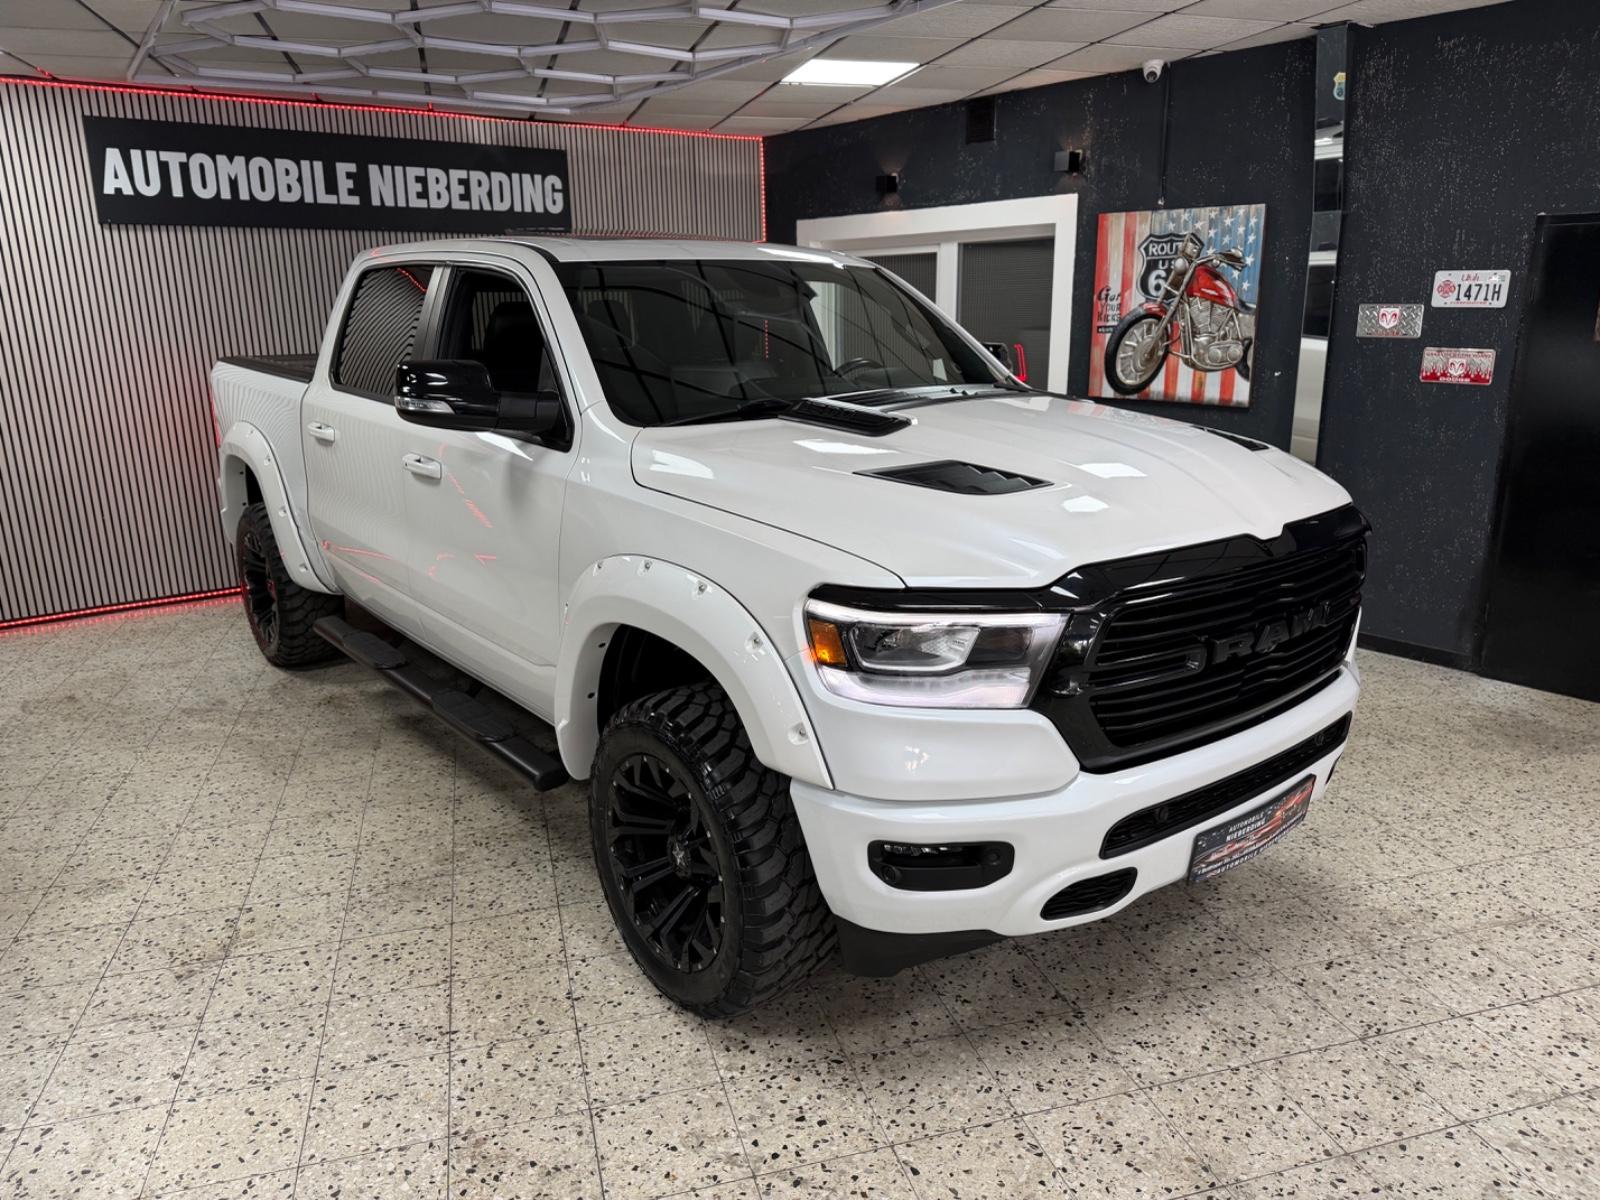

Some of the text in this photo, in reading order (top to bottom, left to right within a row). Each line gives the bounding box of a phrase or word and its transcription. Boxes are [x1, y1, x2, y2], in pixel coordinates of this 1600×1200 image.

[103, 147, 563, 215] AUTOMOBILE NIEBERDING
[1148, 242, 1183, 256] ROUT
[1148, 269, 1167, 297] 6
[1455, 283, 1502, 302] 1471H
[1211, 602, 1331, 665] RAM
